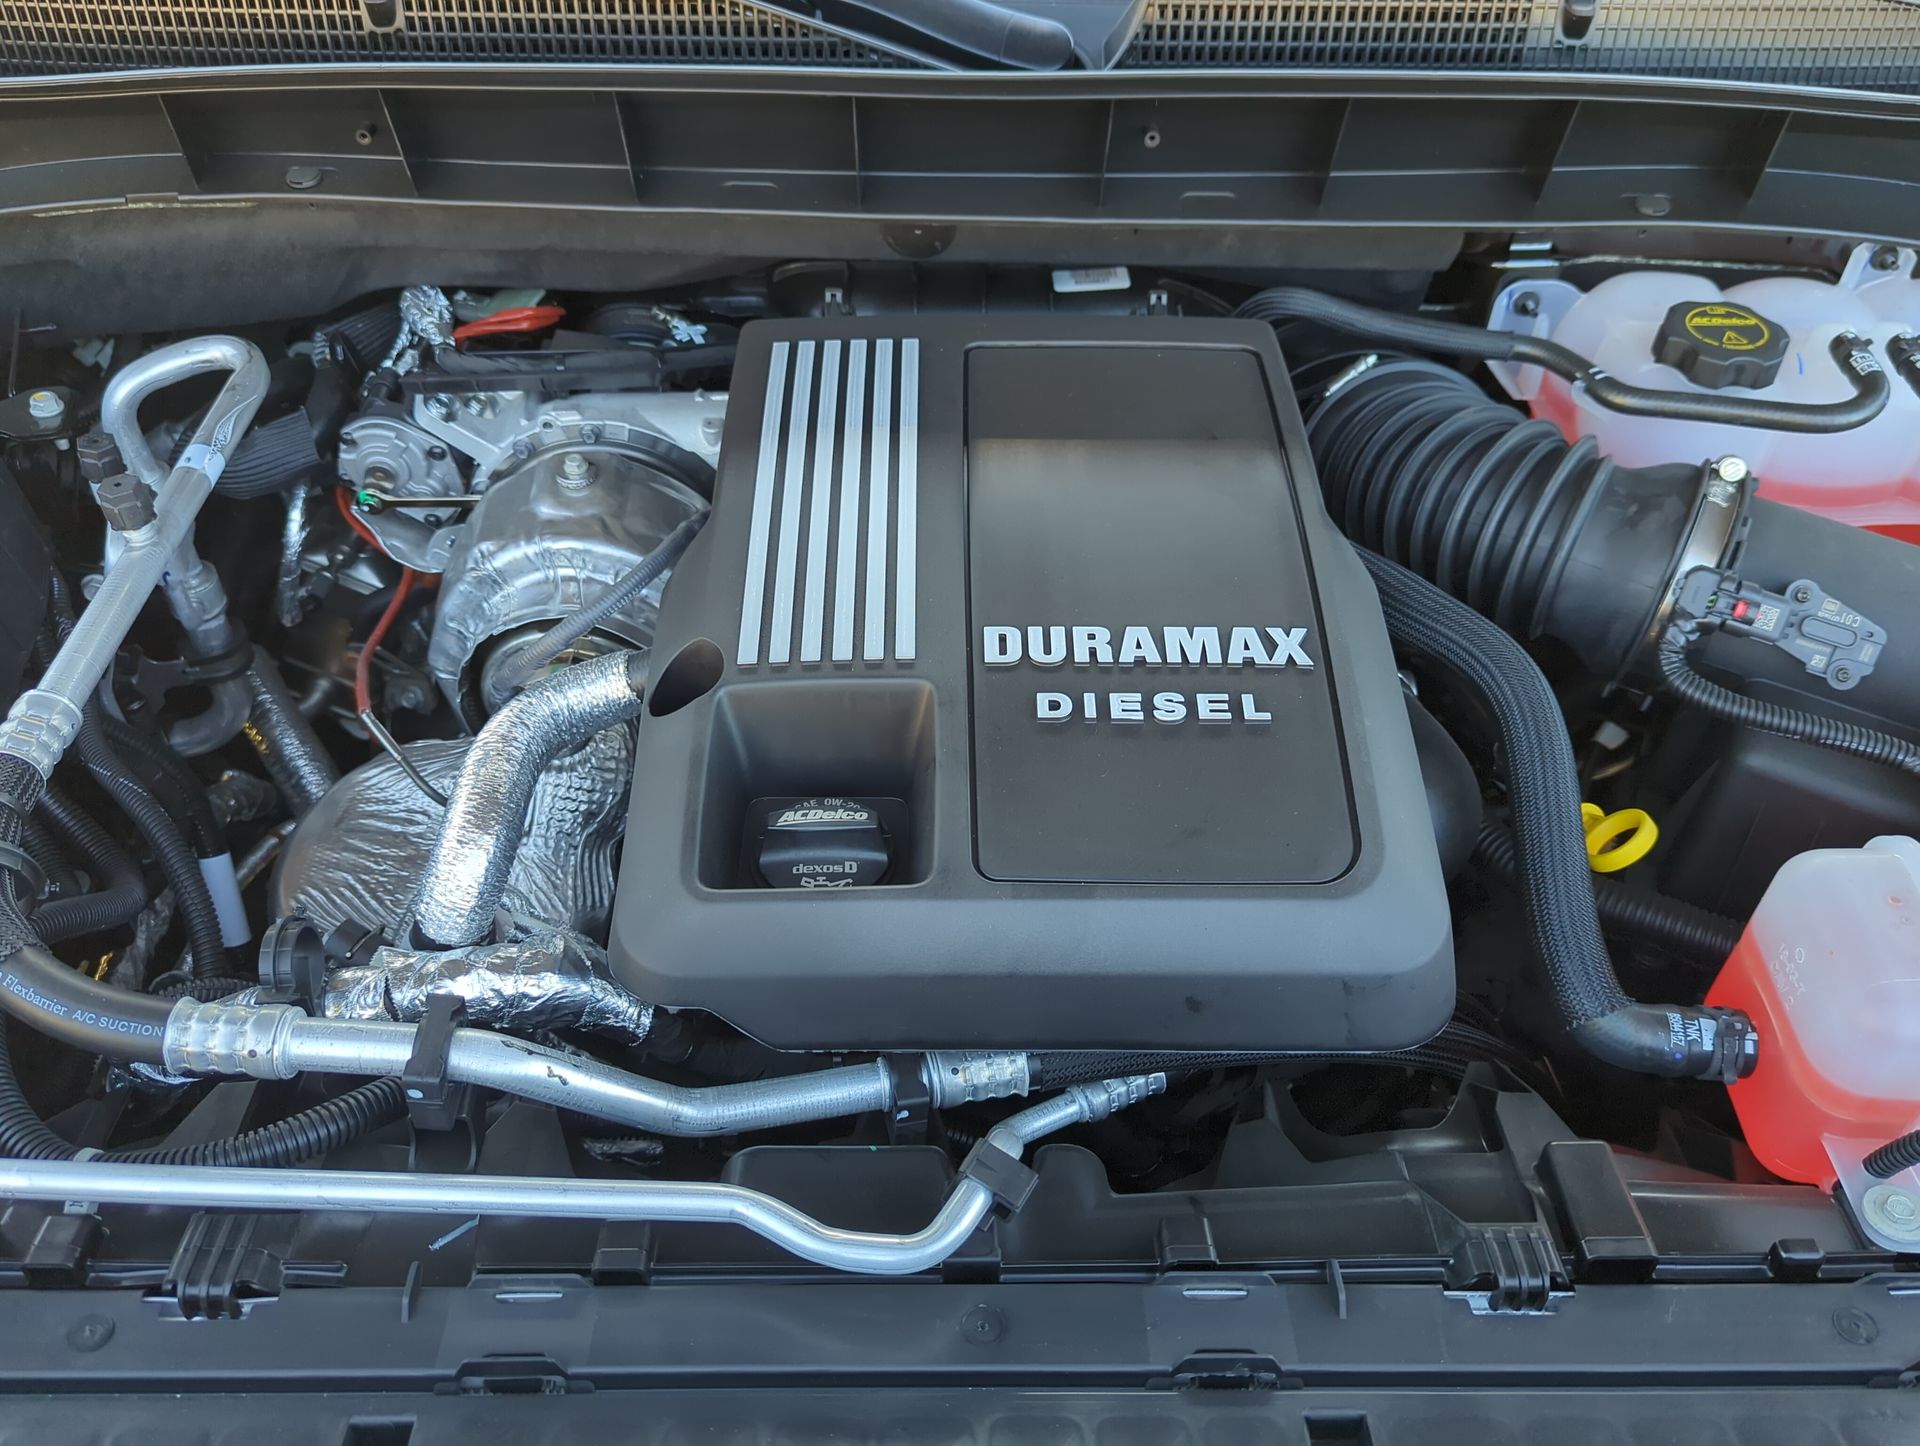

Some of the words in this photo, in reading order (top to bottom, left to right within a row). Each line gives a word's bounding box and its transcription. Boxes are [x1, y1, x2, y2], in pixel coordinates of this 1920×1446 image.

[983, 626, 1314, 668] DURAMAX
[1036, 692, 1273, 723] DIESEL
[777, 808, 869, 823] ACDelco
[2, 974, 69, 1017] Flexbarrier
[72, 1009, 97, 1024] A/C
[98, 1016, 164, 1037] SUCTION
[1684, 1019, 1702, 1042] TNK
